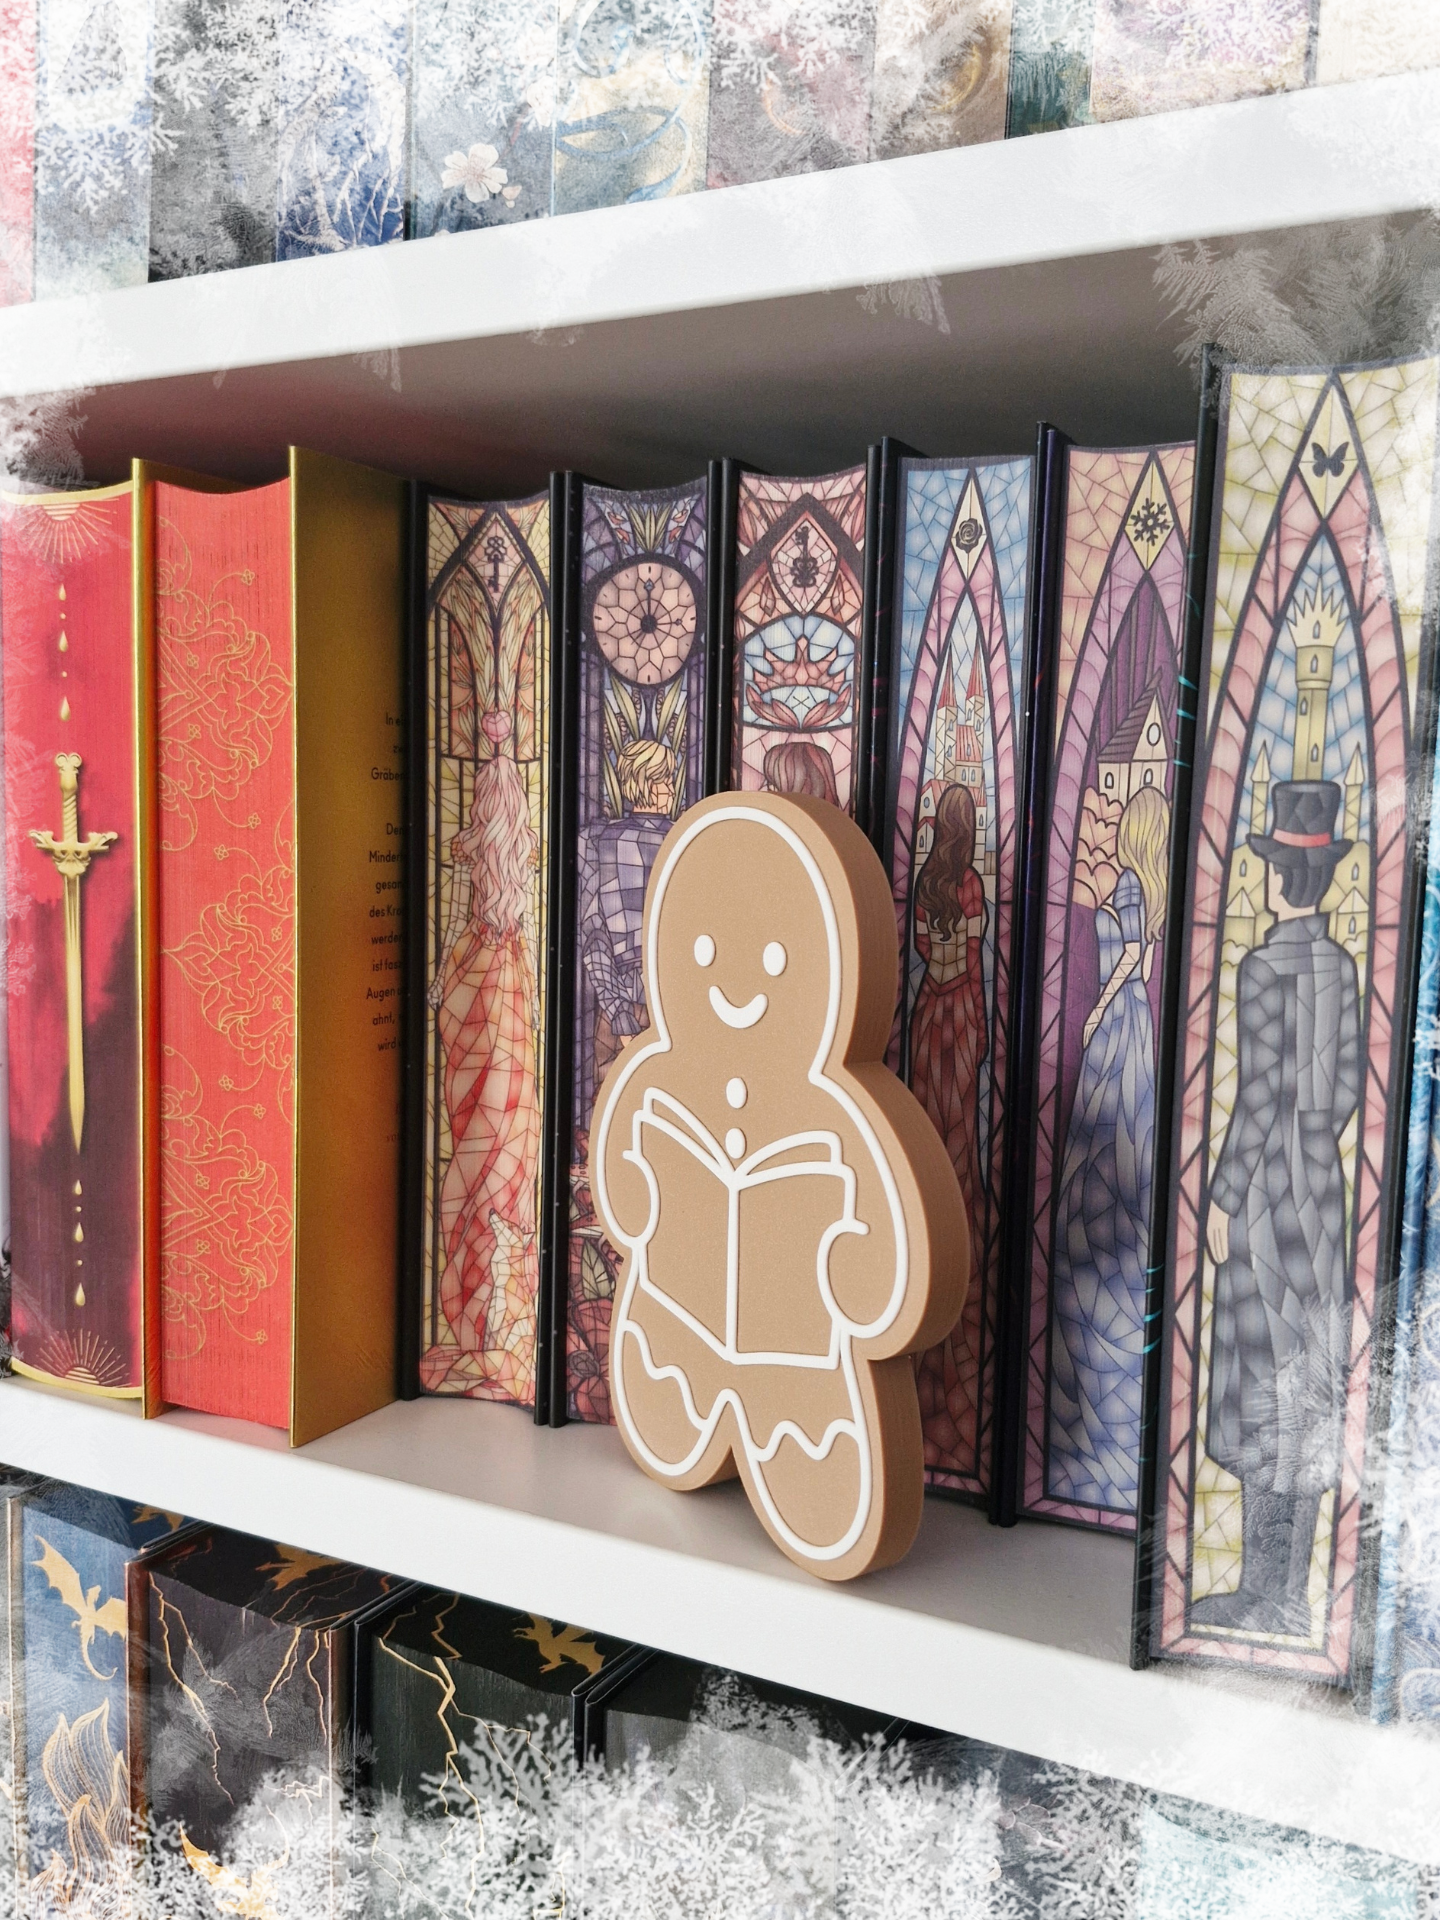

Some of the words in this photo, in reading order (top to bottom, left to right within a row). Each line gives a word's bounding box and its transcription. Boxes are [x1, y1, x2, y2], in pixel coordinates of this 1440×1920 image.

[369, 905, 386, 918] des
[372, 959, 383, 972] ist
[366, 986, 396, 1001] Augen
[372, 1011, 395, 1026] ahnt,
[377, 1036, 397, 1051] wird
